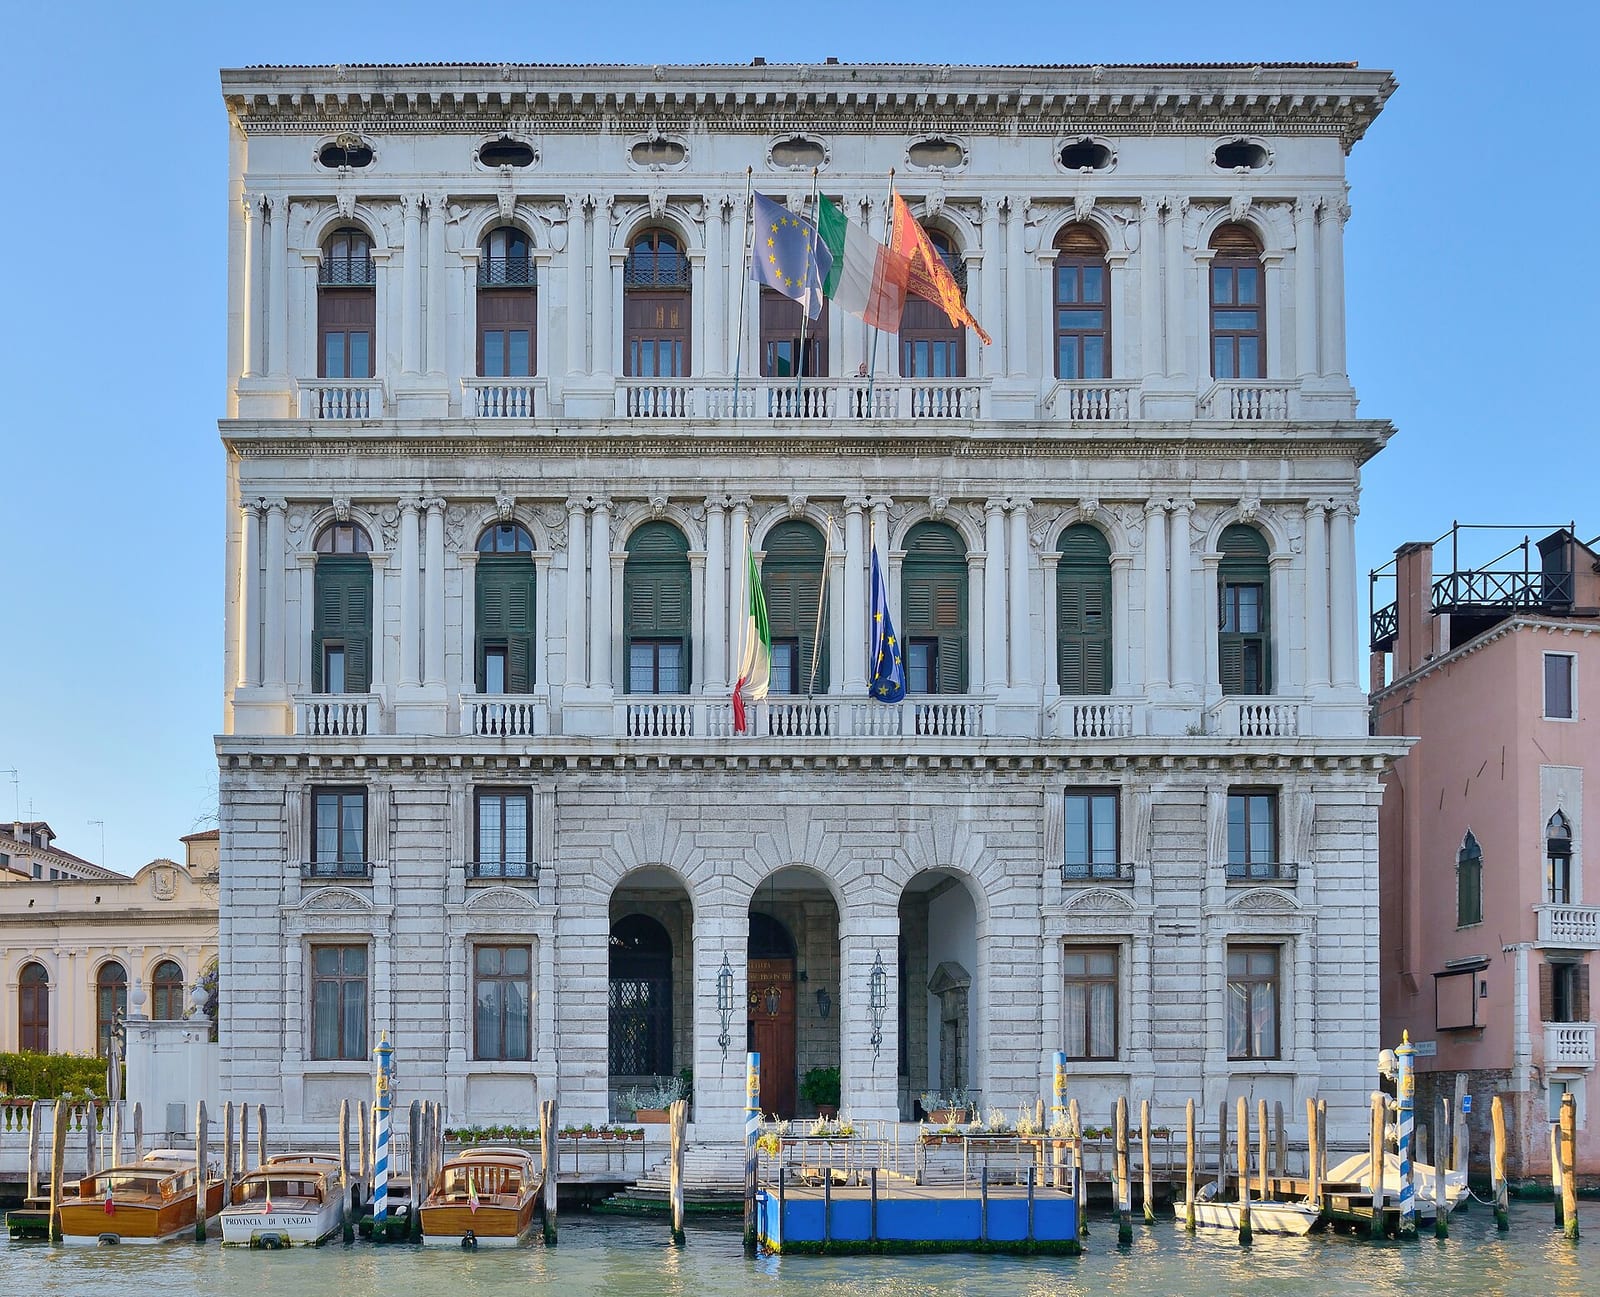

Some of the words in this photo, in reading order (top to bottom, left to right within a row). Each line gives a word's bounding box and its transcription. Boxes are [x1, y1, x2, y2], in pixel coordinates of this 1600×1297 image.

[226, 1218, 262, 1226] PROVINCIA
[268, 1218, 276, 1226] DI
[282, 1217, 312, 1225] VENEZIA
